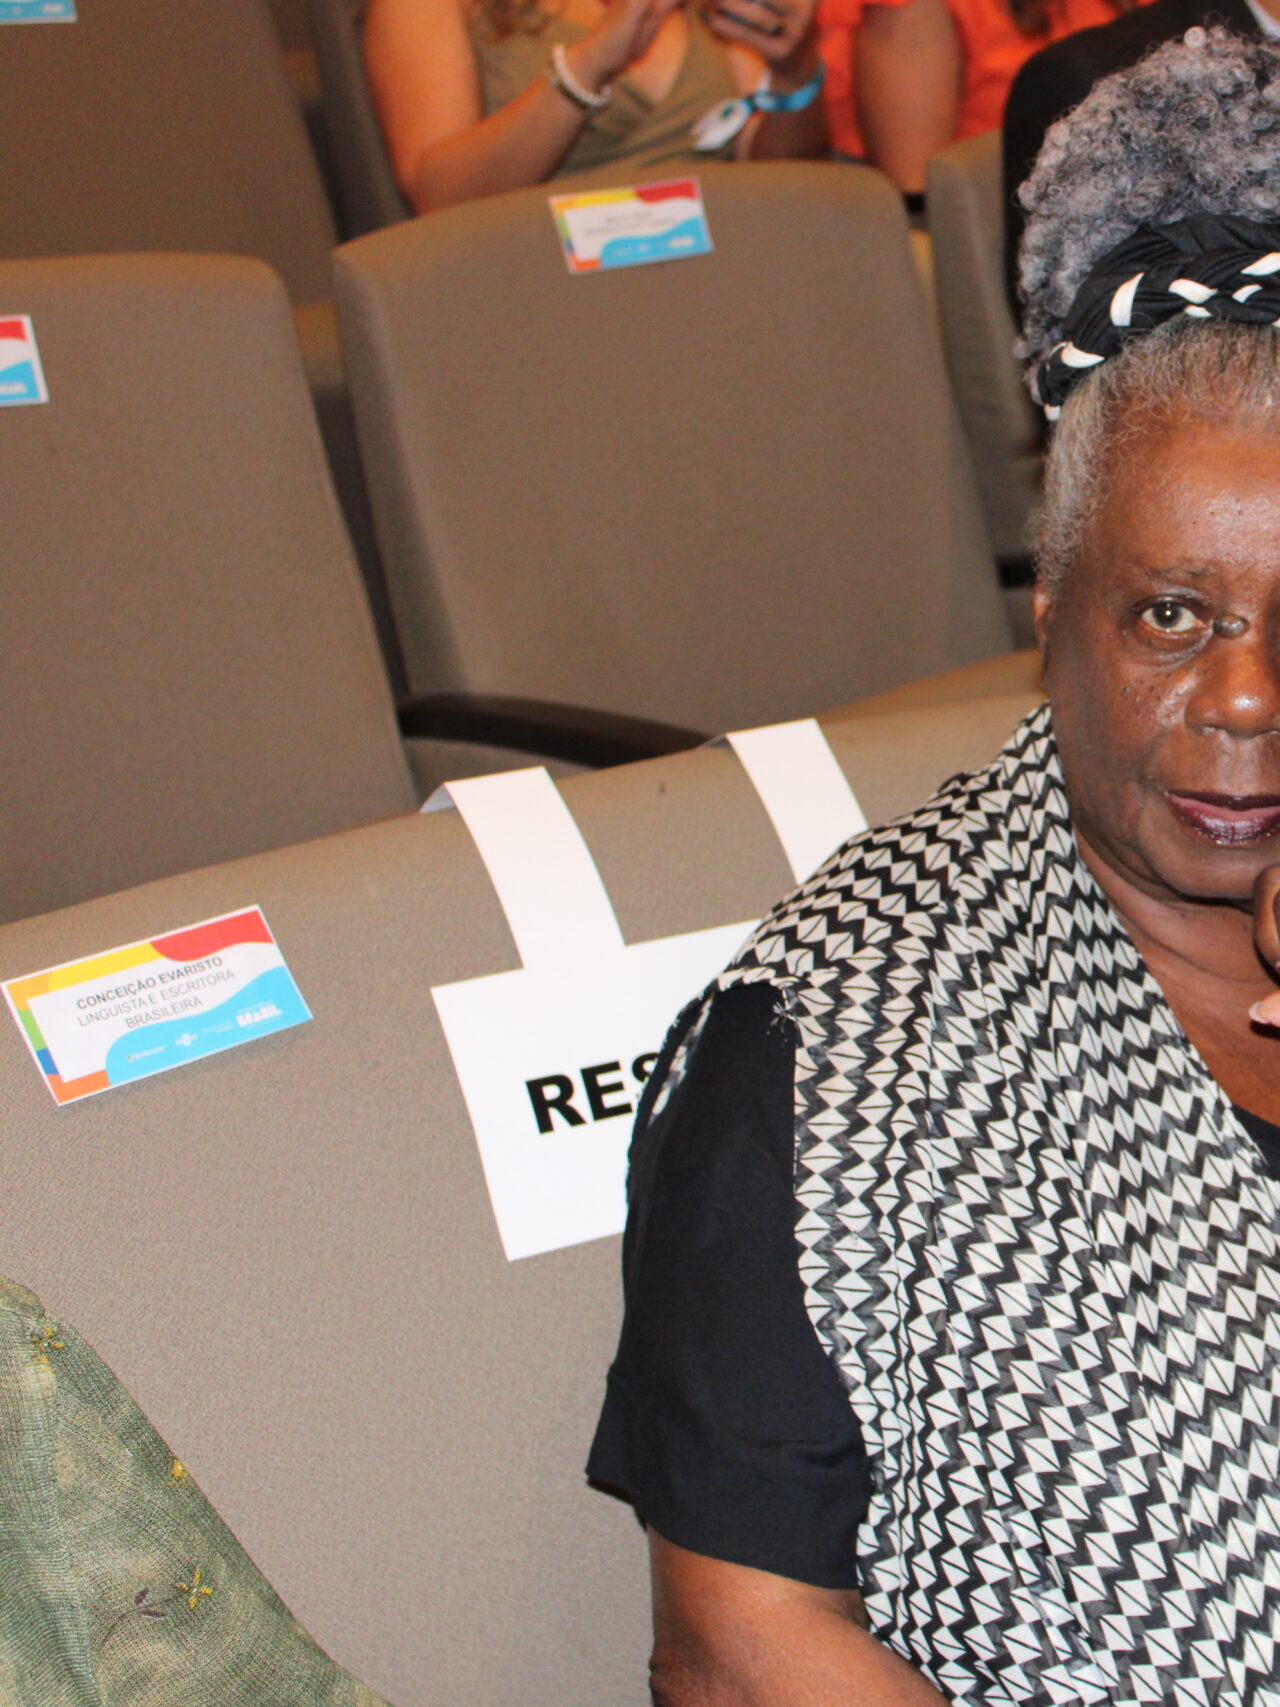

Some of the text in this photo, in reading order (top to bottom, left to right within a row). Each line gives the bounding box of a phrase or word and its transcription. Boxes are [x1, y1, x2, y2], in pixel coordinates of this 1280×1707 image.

[76, 956, 223, 1010] CONCEIÇÃO EVARISTO
[77, 969, 236, 1027] LINGUISTA E ESCRITORA
[125, 996, 203, 1030] BRASILEIRA
